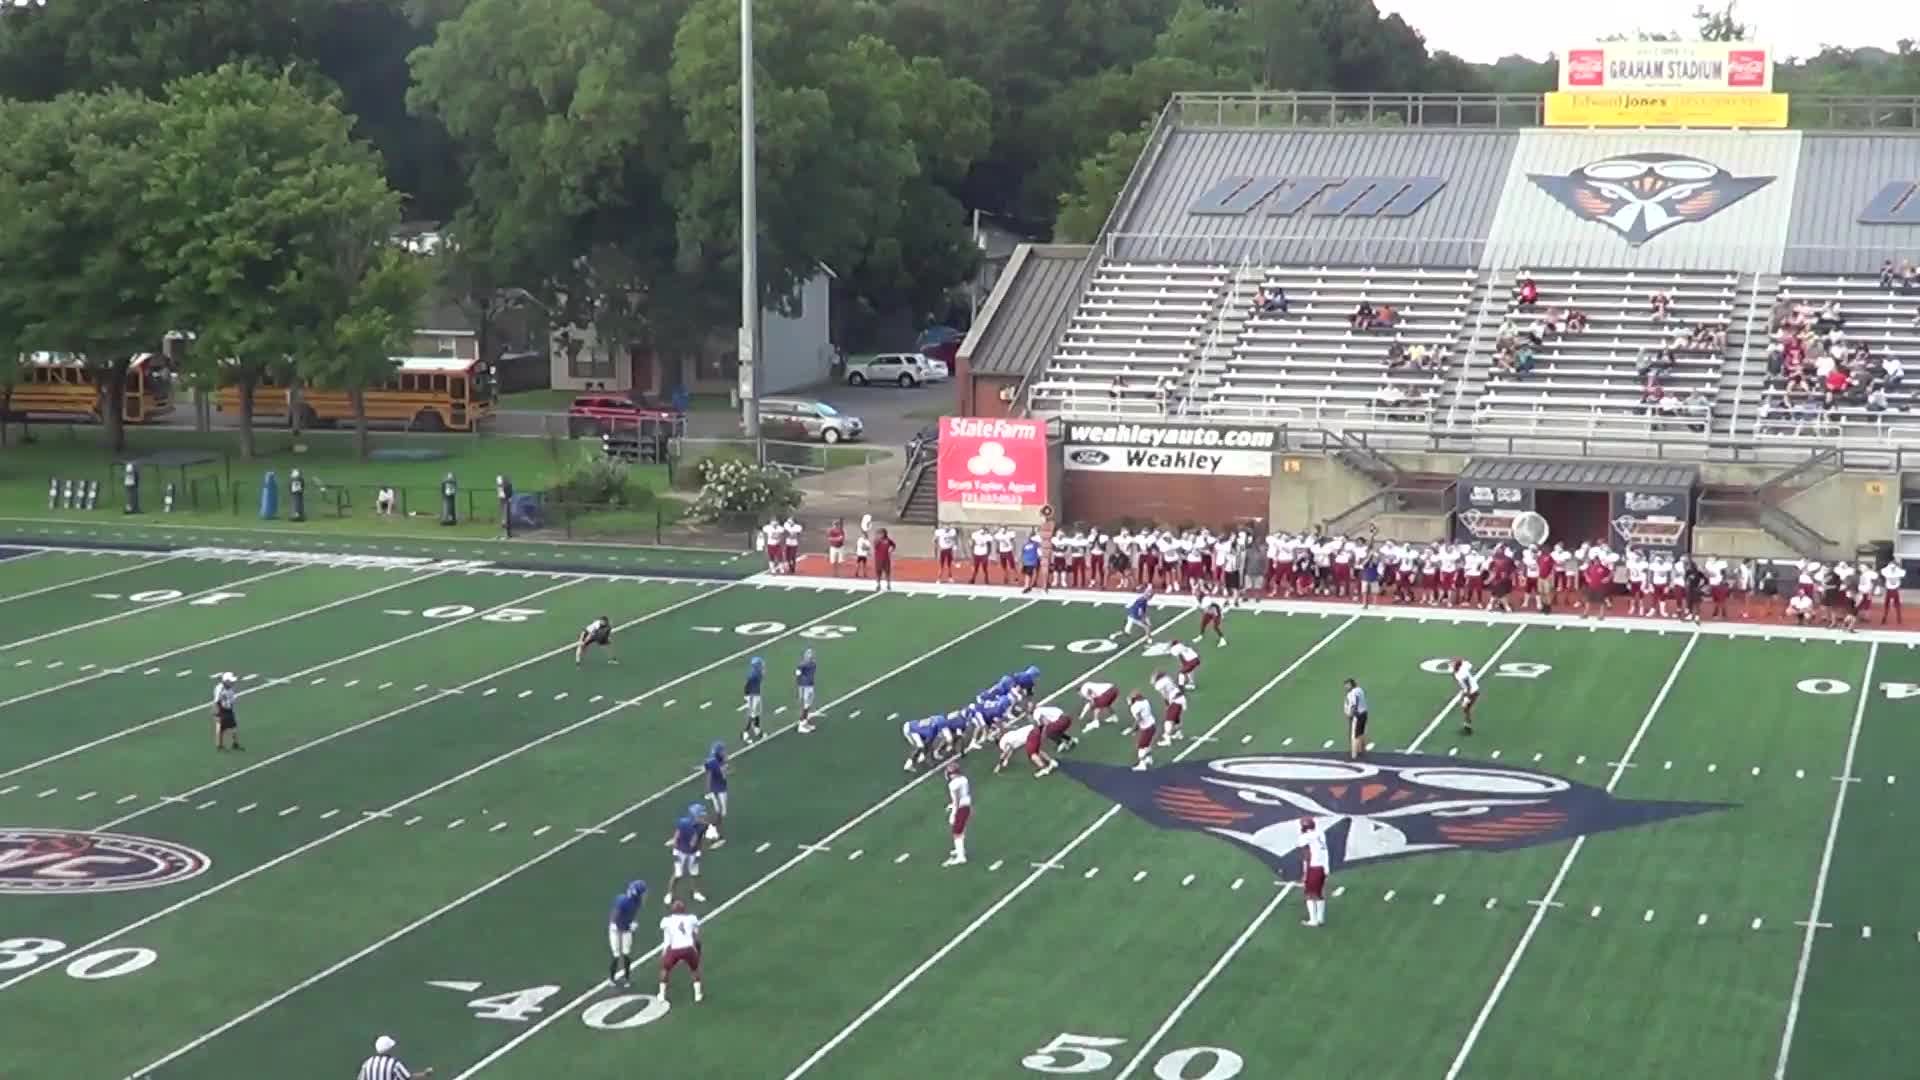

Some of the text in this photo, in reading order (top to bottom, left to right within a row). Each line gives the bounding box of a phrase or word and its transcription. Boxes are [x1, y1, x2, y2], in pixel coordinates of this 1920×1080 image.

[1610, 60, 1722, 80] GRAHAM STADIUM
[1625, 95, 1667, 109] Jones
[1070, 424, 1274, 447] weakleyauto.com
[1127, 450, 1222, 473] Weakley
